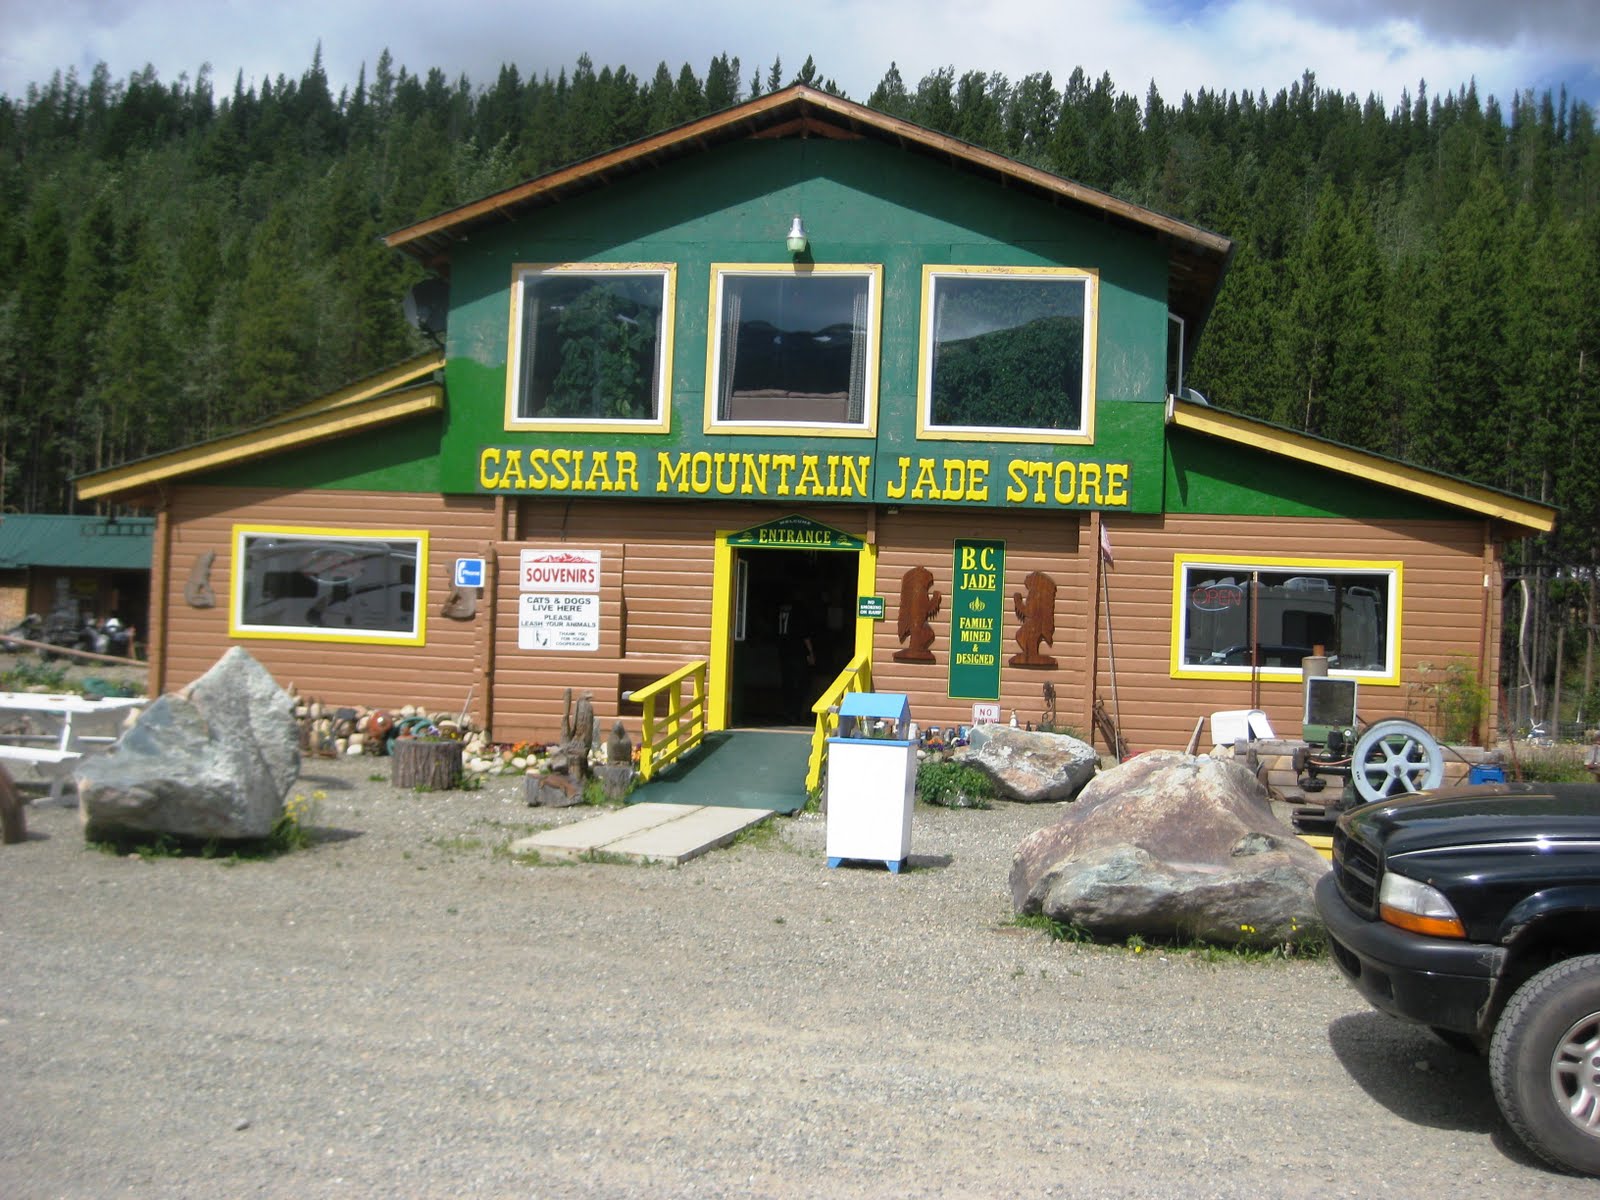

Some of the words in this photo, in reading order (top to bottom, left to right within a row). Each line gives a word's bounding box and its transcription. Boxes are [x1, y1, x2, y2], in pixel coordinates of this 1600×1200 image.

[479, 447, 639, 492] CASSIAR
[656, 451, 870, 497] MOUNTAIN
[887, 457, 989, 501] JADE
[1006, 459, 1129, 506] STORE
[759, 529, 831, 543] ENTRANCE
[526, 567, 595, 583] SOUVENIRS
[960, 573, 996, 589] JADE
[526, 596, 550, 604] CATS
[564, 597, 591, 605] DOGS
[1192, 587, 1242, 606] OPEN
[532, 604, 553, 612] LIVE
[960, 617, 993, 629] FAMILY
[961, 630, 991, 642] MINED
[972, 643, 979, 652] &
[956, 653, 994, 665] DESIGNED
[979, 708, 992, 716] NO
